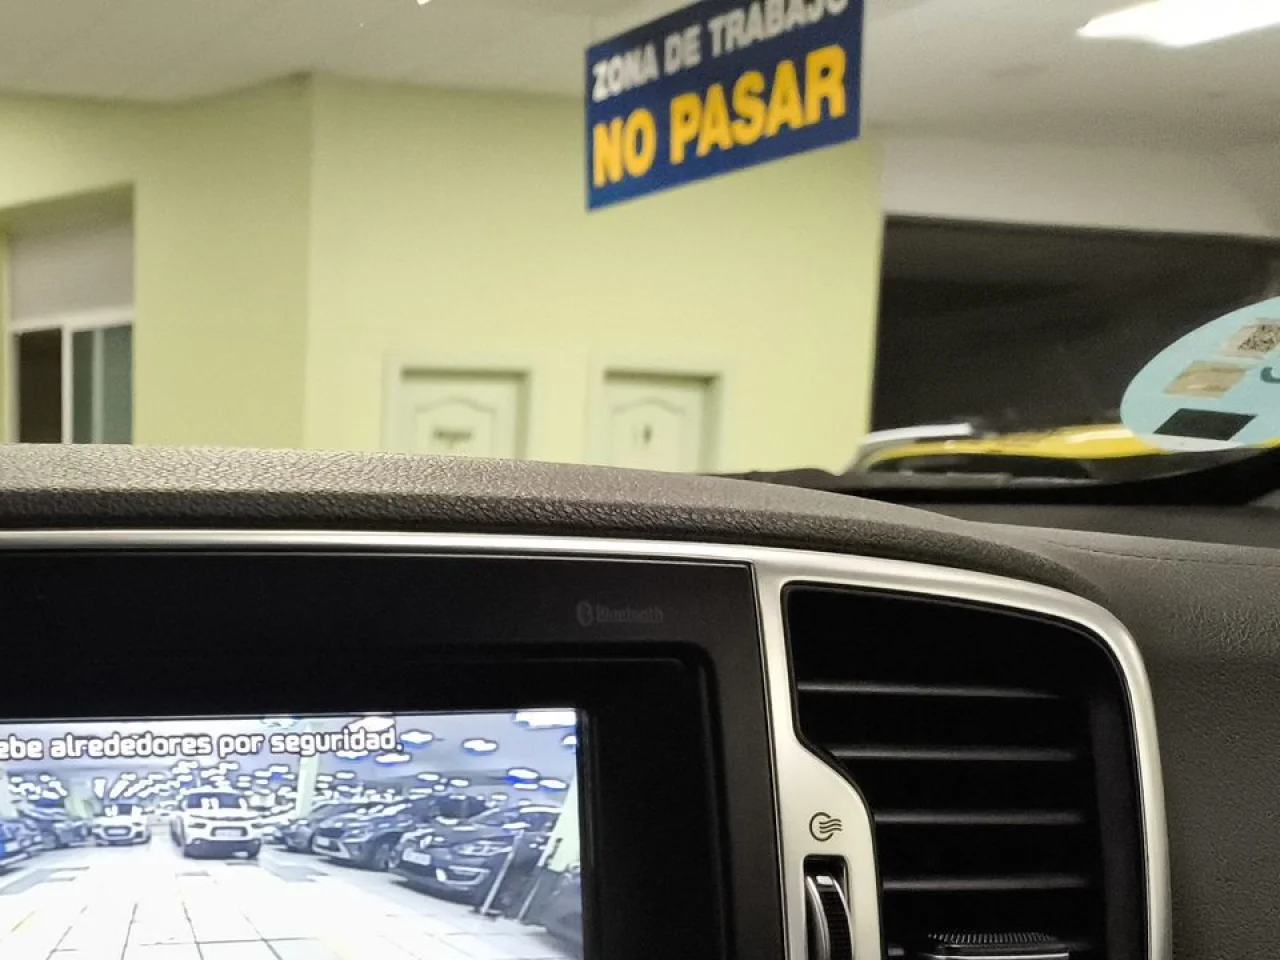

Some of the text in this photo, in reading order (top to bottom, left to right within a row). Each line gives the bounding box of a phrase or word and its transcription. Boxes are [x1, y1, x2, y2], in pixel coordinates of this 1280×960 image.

[591, 40, 659, 103] ZONA
[663, 22, 702, 76] DE
[592, 43, 848, 188] NO PASAR
[50, 730, 213, 760] alrededores
[218, 733, 266, 759] por
[269, 726, 405, 757] seguridad.
